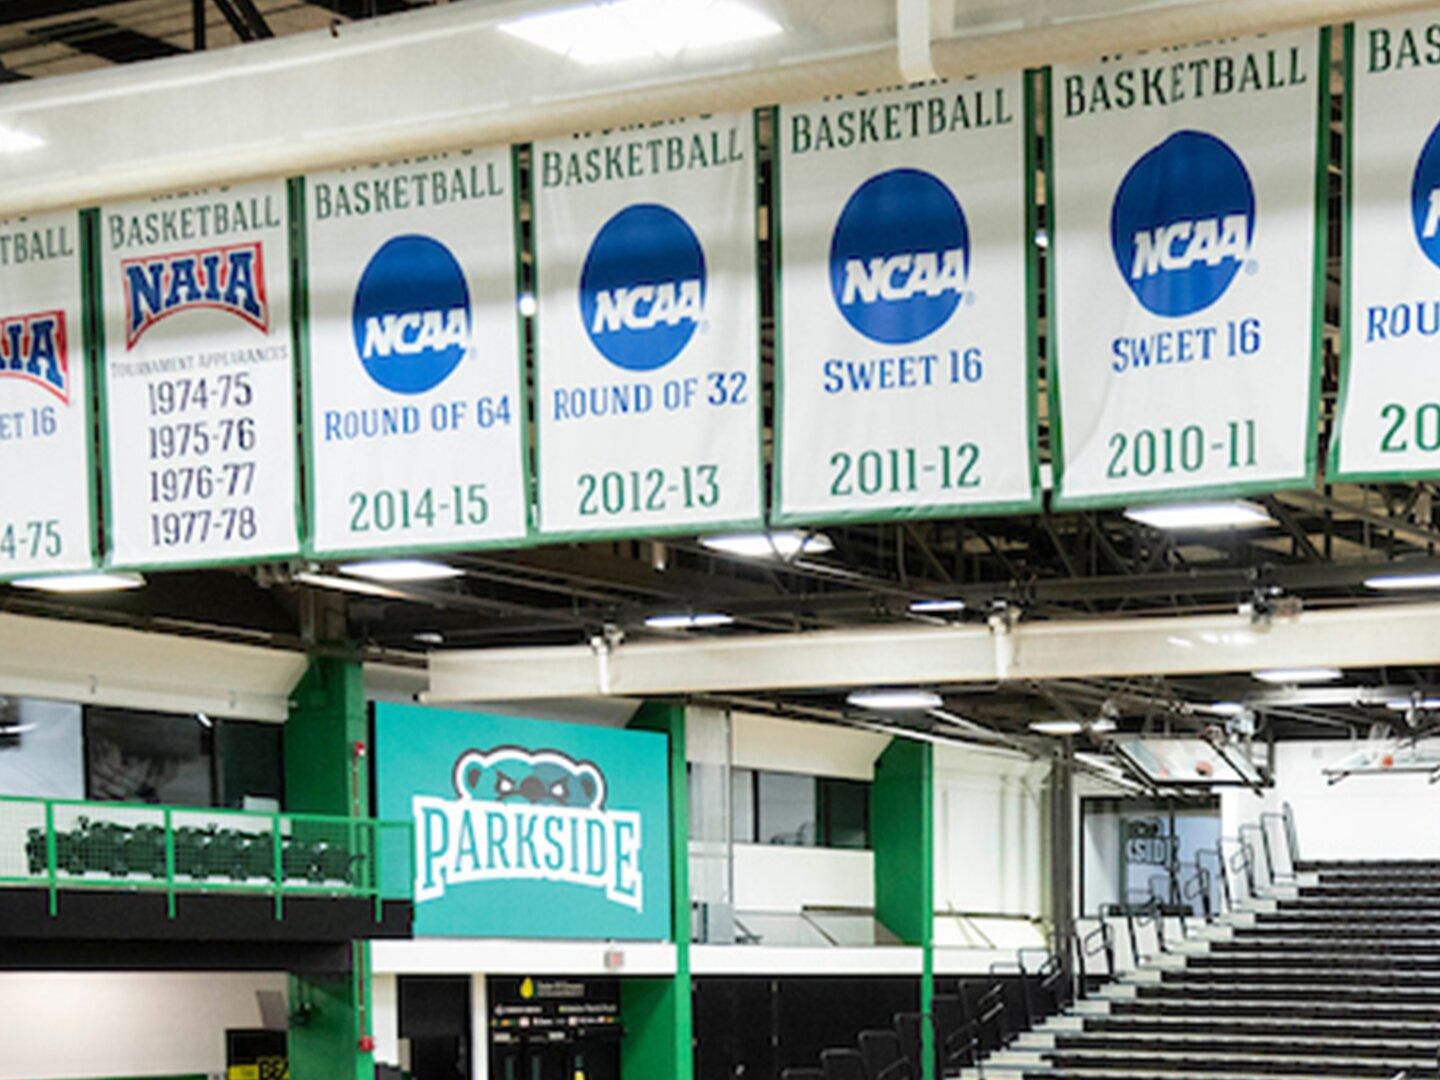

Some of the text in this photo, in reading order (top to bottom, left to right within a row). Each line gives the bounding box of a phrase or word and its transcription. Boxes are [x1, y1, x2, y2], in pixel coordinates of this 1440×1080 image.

[1064, 47, 1307, 117] BASKETBALL
[791, 89, 1013, 153] BASKETBALL
[542, 128, 743, 188] BASKETBALL
[315, 163, 503, 219] BASKETBALL
[109, 196, 281, 249] BASKETBALL
[1132, 215, 1253, 280] NCAA
[126, 250, 262, 331] NAIA
[843, 249, 968, 305] NCAA
[363, 307, 471, 358] NCAA
[592, 279, 701, 333] NCAA
[824, 349, 983, 393] SWEET 16
[1112, 319, 1261, 373] SWEET 16
[148, 372, 253, 415] 1974-75
[325, 395, 511, 442] ROUND OF 64
[554, 372, 748, 422] ROUND OF 32
[32, 405, 57, 437] 16
[149, 417, 255, 459] 1975-76
[830, 443, 981, 496] 2011-12
[1106, 419, 1256, 479] 2010-11
[151, 462, 256, 502] 1976-77
[349, 484, 489, 532] 2014-15
[578, 465, 719, 516] 2012-13
[152, 506, 257, 546] 1977-78
[418, 802, 640, 903] PARKSIDE
